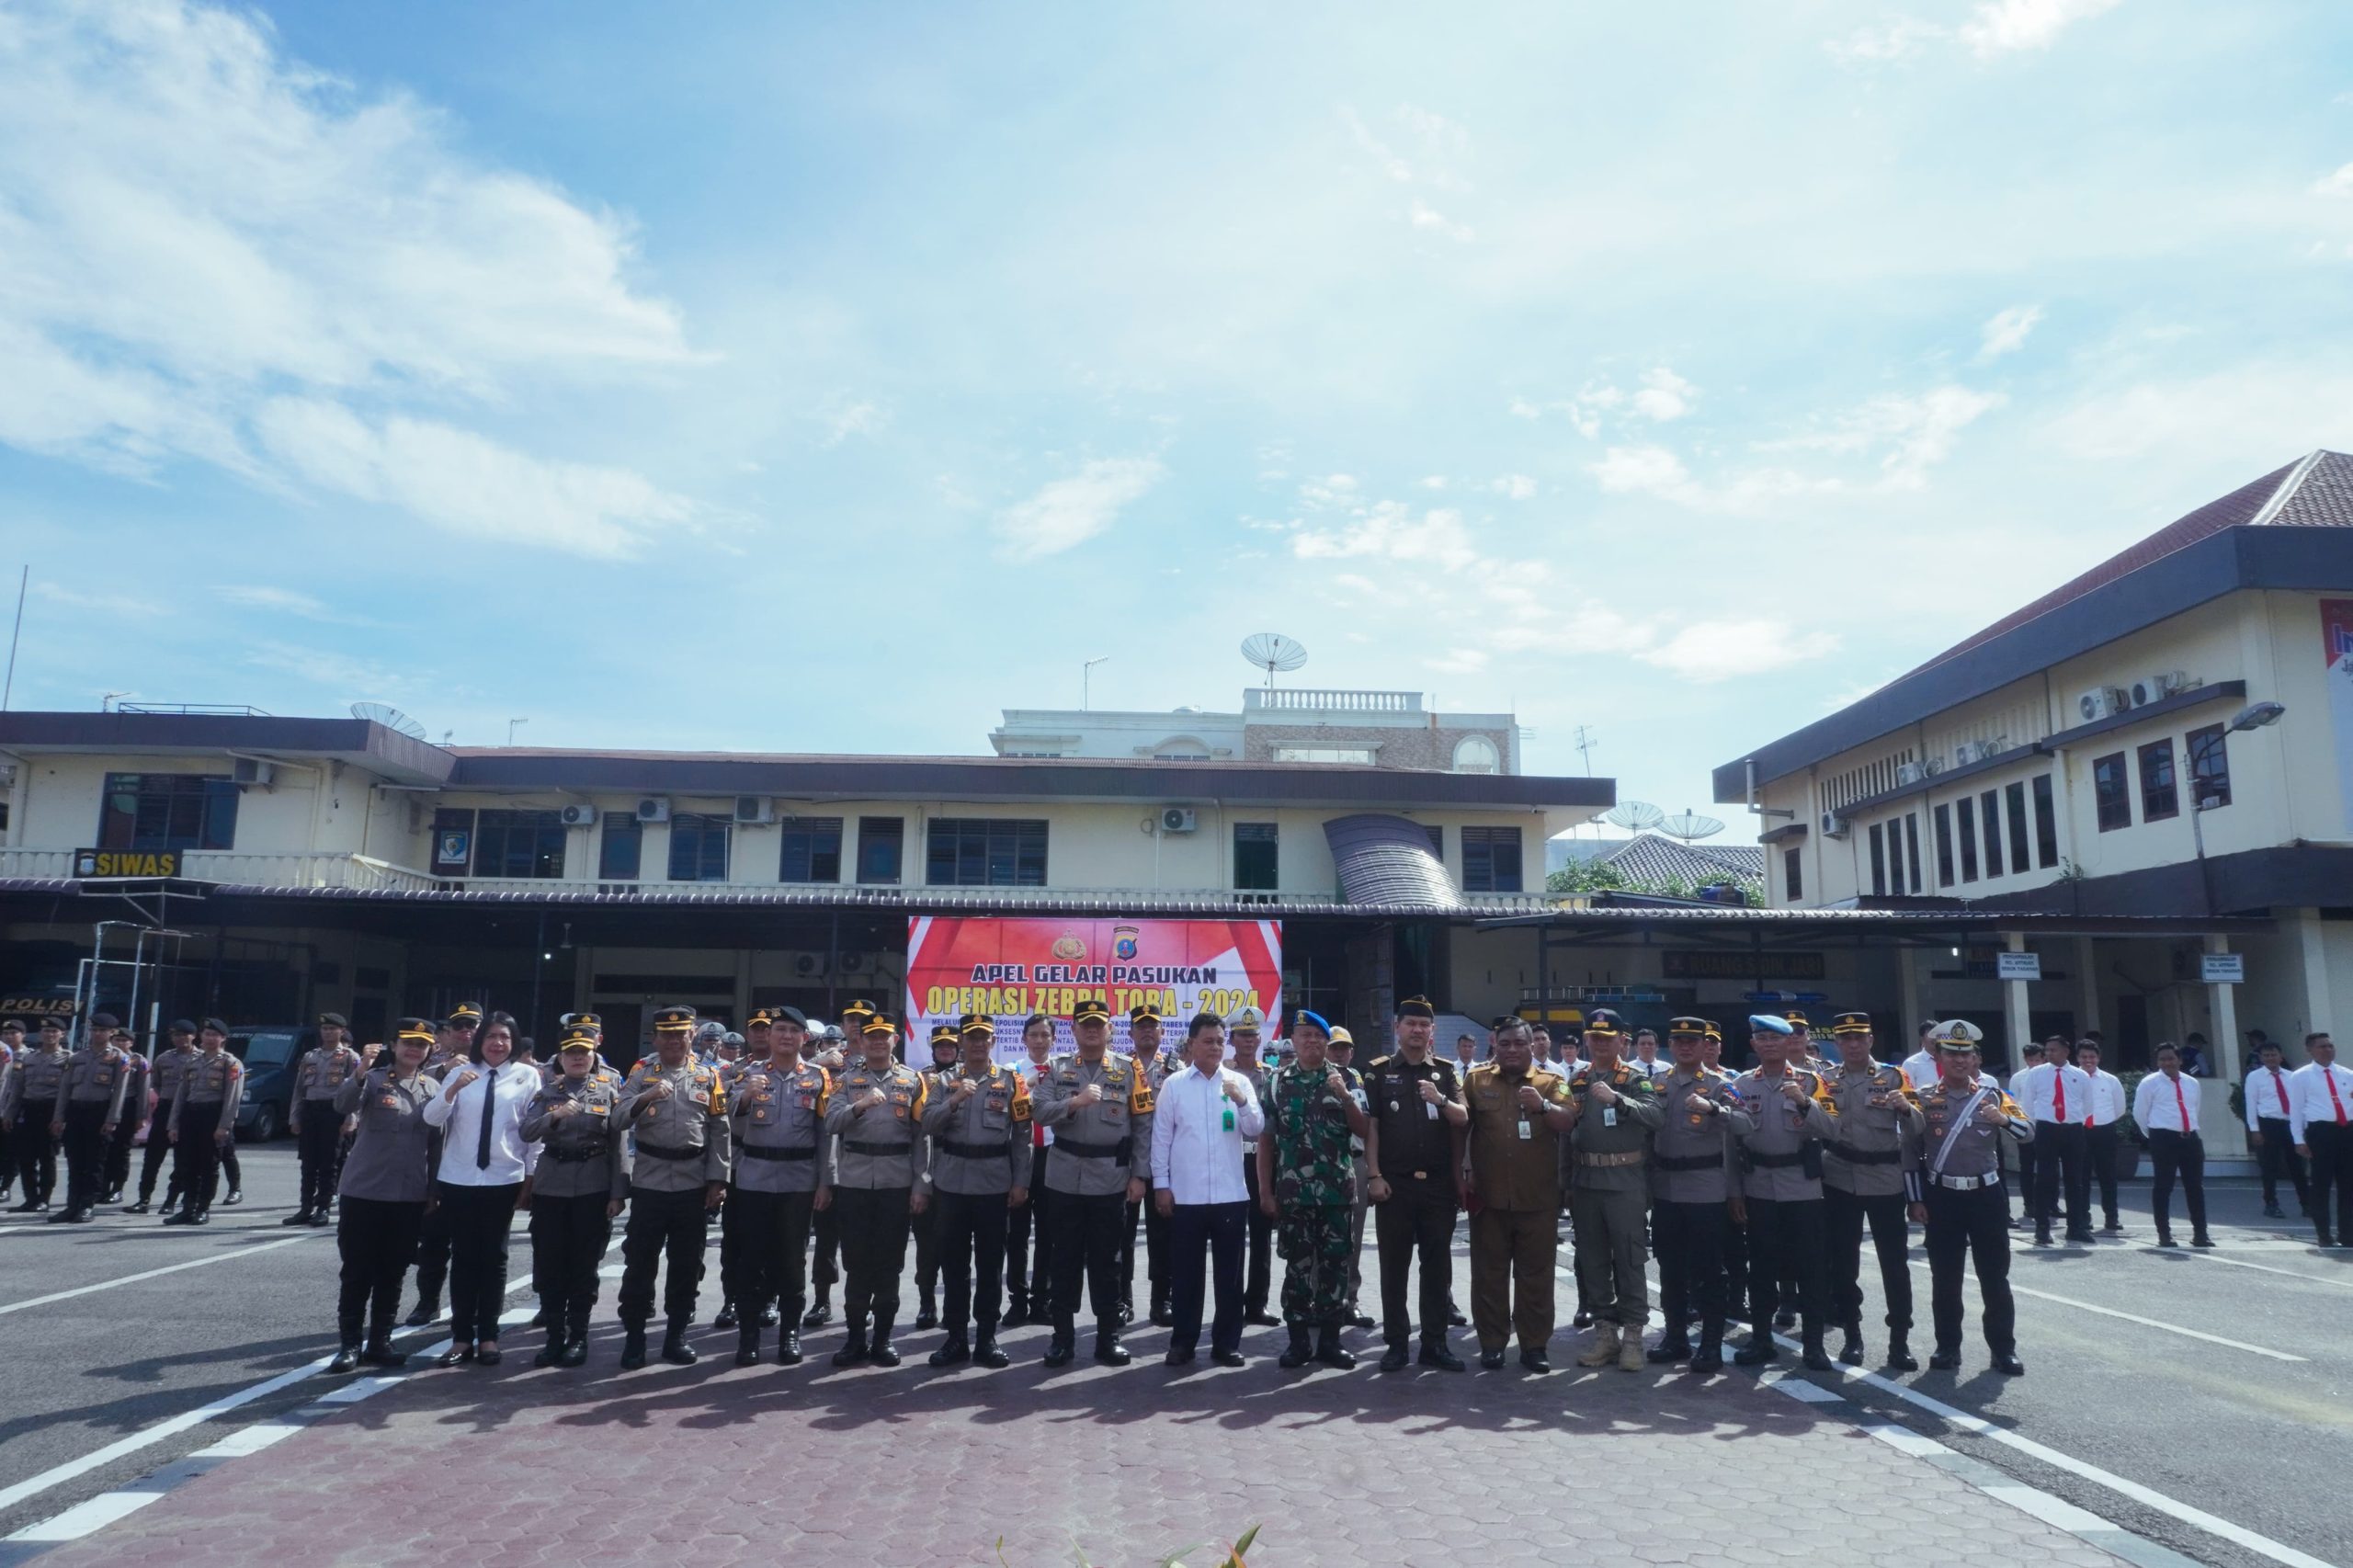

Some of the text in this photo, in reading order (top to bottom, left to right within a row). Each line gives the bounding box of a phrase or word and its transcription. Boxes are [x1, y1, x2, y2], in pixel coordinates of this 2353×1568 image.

[96, 853, 175, 876] SIWAS
[972, 964, 1217, 984] APEL GELAR PASUKAN
[926, 986, 1028, 1015] OPERASI
[1199, 988, 1259, 1017] 2024
